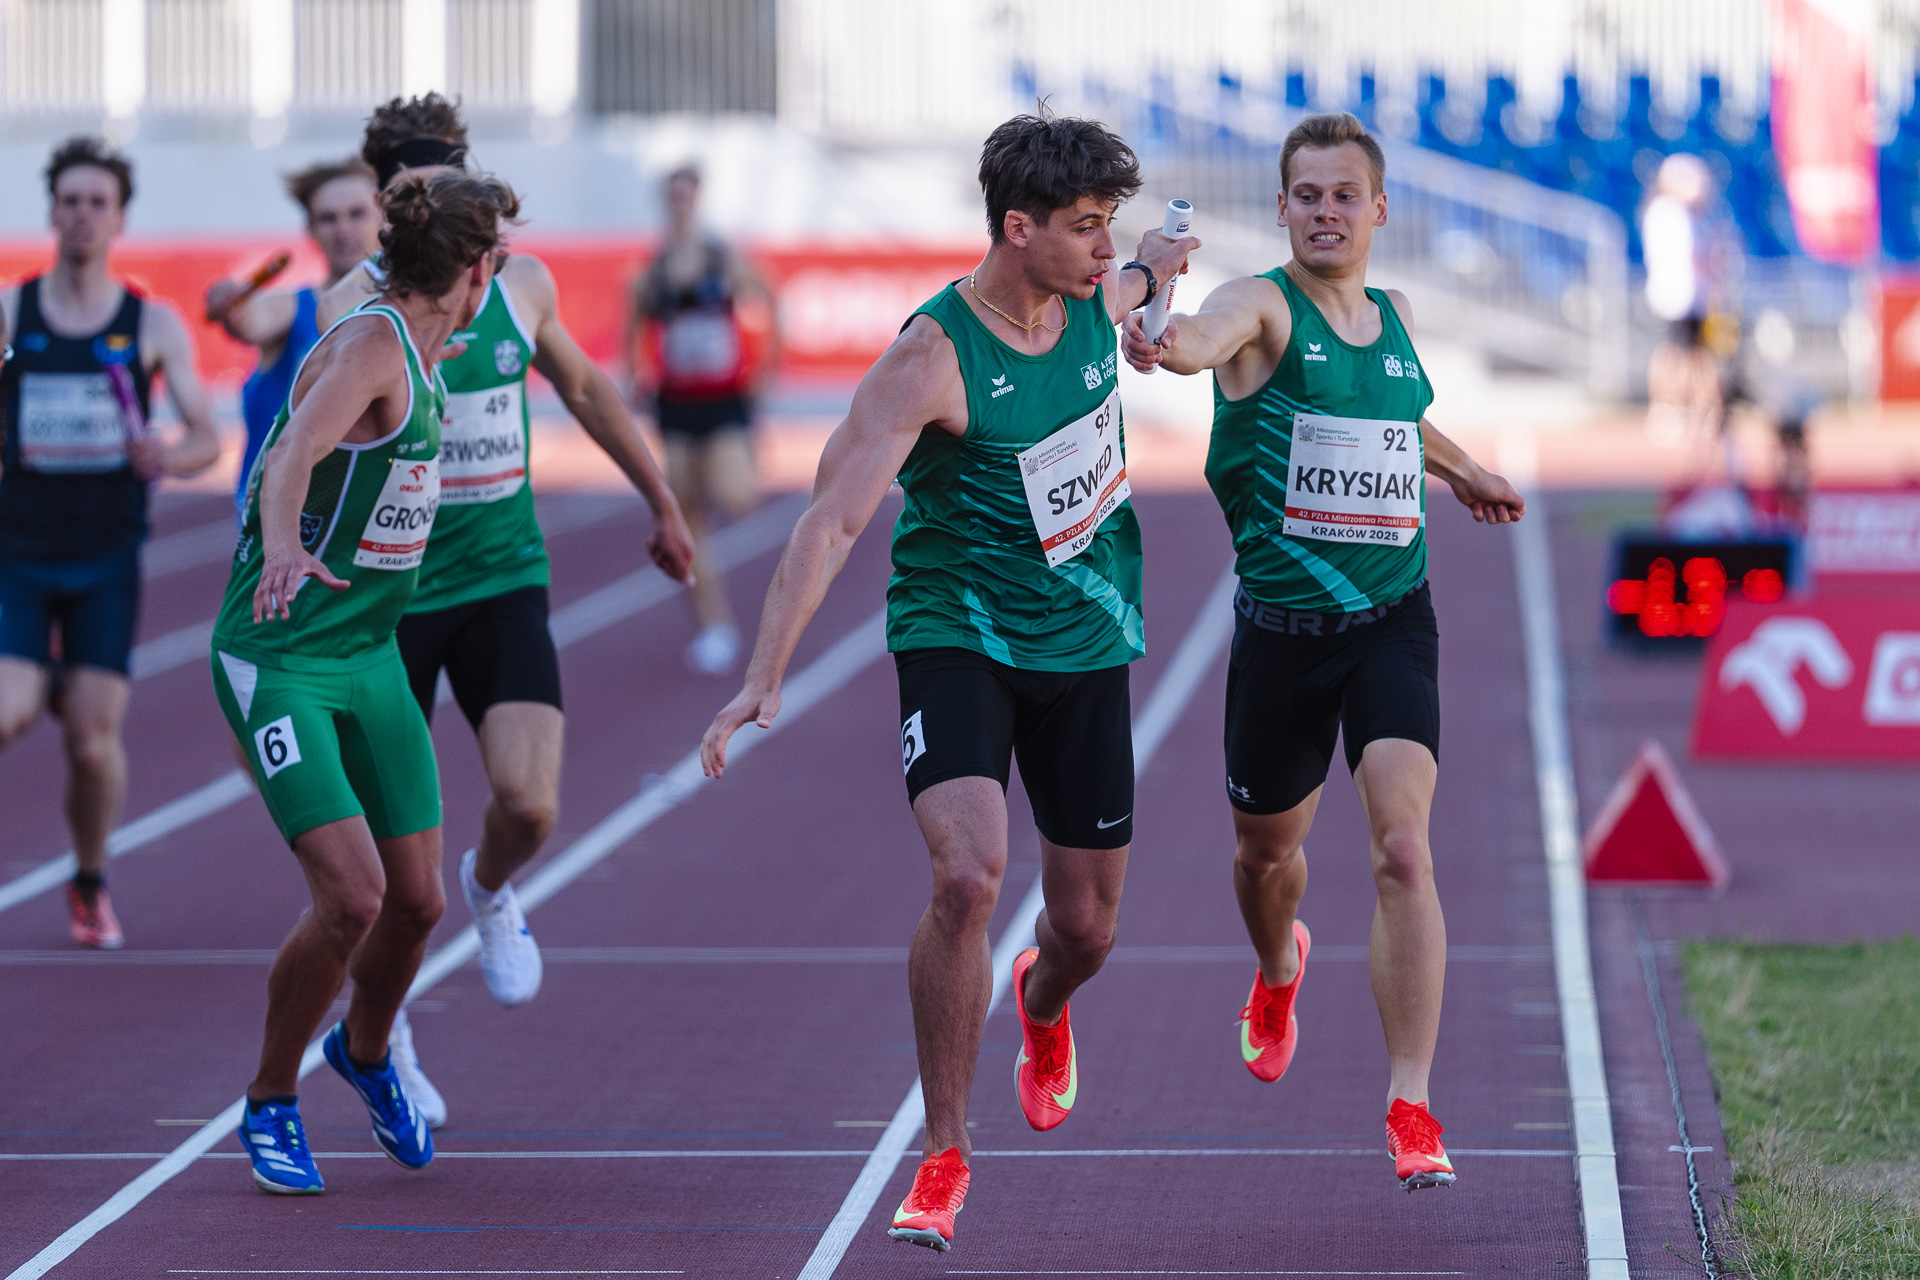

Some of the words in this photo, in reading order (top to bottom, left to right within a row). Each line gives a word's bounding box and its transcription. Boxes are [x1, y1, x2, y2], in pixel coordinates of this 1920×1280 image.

[1304, 352, 1327, 362] erima
[991, 383, 1015, 399] erima
[486, 393, 509, 416] 49
[1095, 403, 1110, 438] 93
[1315, 433, 1334, 441] Sportu
[1337, 435, 1360, 443] Turystyki
[1316, 427, 1350, 436] Ministerstwo
[1383, 427, 1407, 452] 92
[1038, 440, 1067, 460] Ministerstwo
[1040, 453, 1055, 467] Sportu
[1057, 441, 1078, 457] Turystyki
[1047, 443, 1112, 516] SZWED
[1295, 465, 1417, 500] KRYSIAK
[1099, 496, 1117, 519] 2025
[1298, 509, 1310, 519] 42.
[1311, 511, 1330, 521] PZLA
[1331, 513, 1377, 525] Mistrzostwa
[1377, 516, 1399, 526] Polski
[1400, 518, 1412, 527] U23
[1054, 532, 1066, 544] 42.
[1065, 524, 1083, 538] PZLA
[1310, 525, 1367, 540] KRAKÓW
[1369, 529, 1399, 541] 2025
[263, 726, 288, 767] 6
